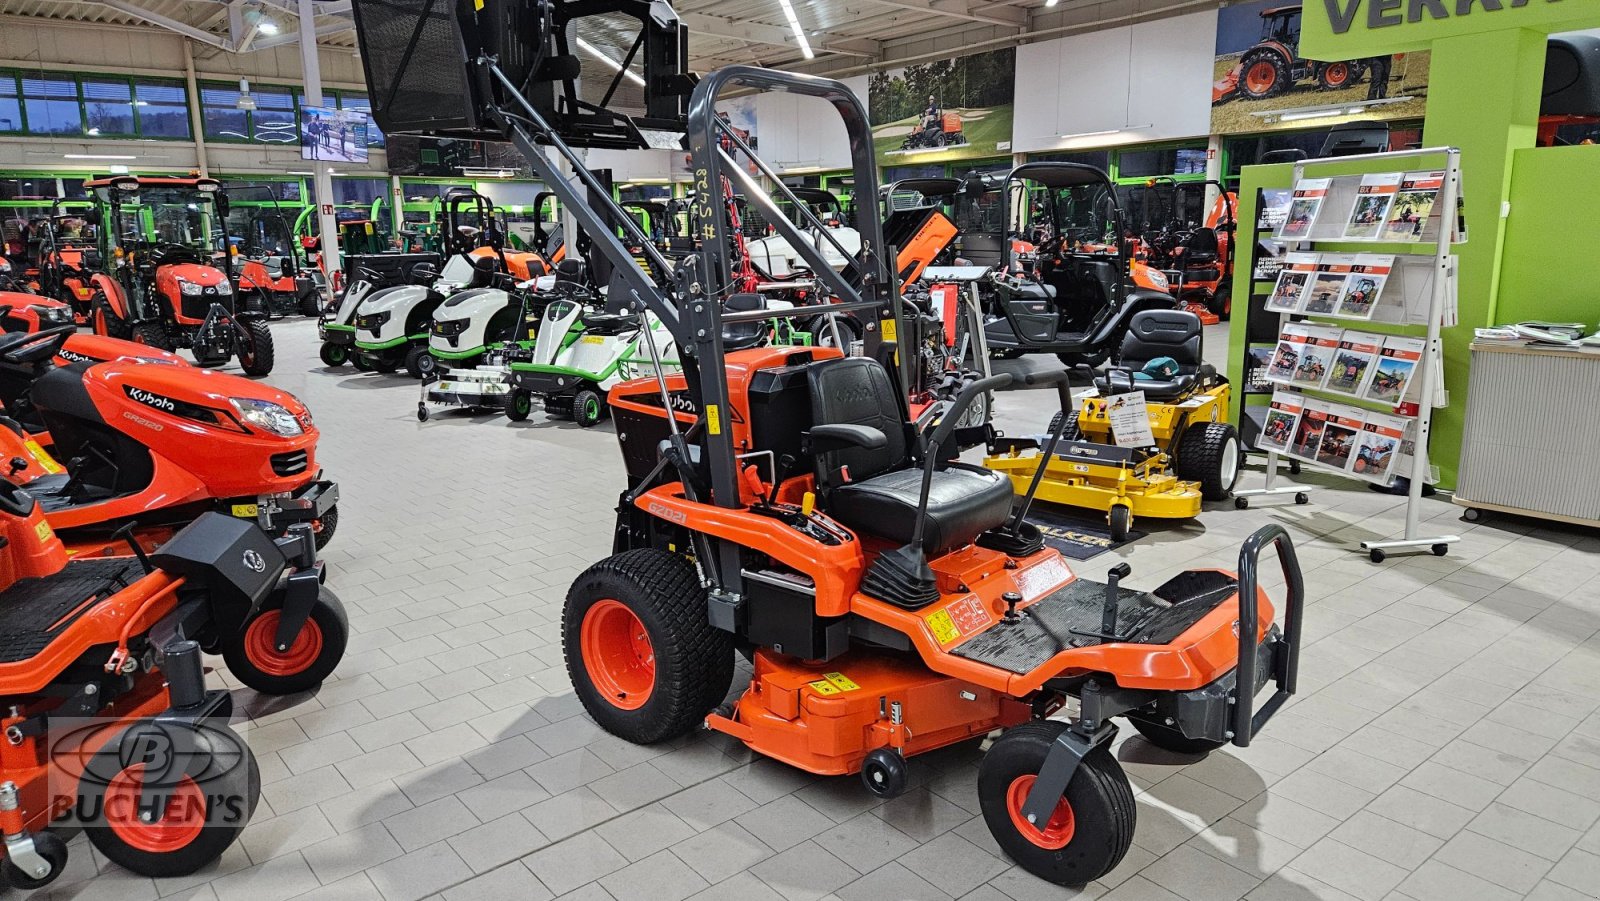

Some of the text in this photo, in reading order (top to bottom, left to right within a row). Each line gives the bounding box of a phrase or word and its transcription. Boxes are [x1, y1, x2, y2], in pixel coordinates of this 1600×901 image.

[1323, 0, 1562, 34] VER
[1354, 264, 1364, 273] LX
[59, 349, 94, 362] Kubo
[1384, 348, 1392, 356] M
[130, 387, 175, 411] Kubota
[662, 393, 696, 412] ubo
[123, 411, 164, 432] GR2120
[1364, 424, 1375, 433] LK
[1035, 524, 1115, 548] ALKER
